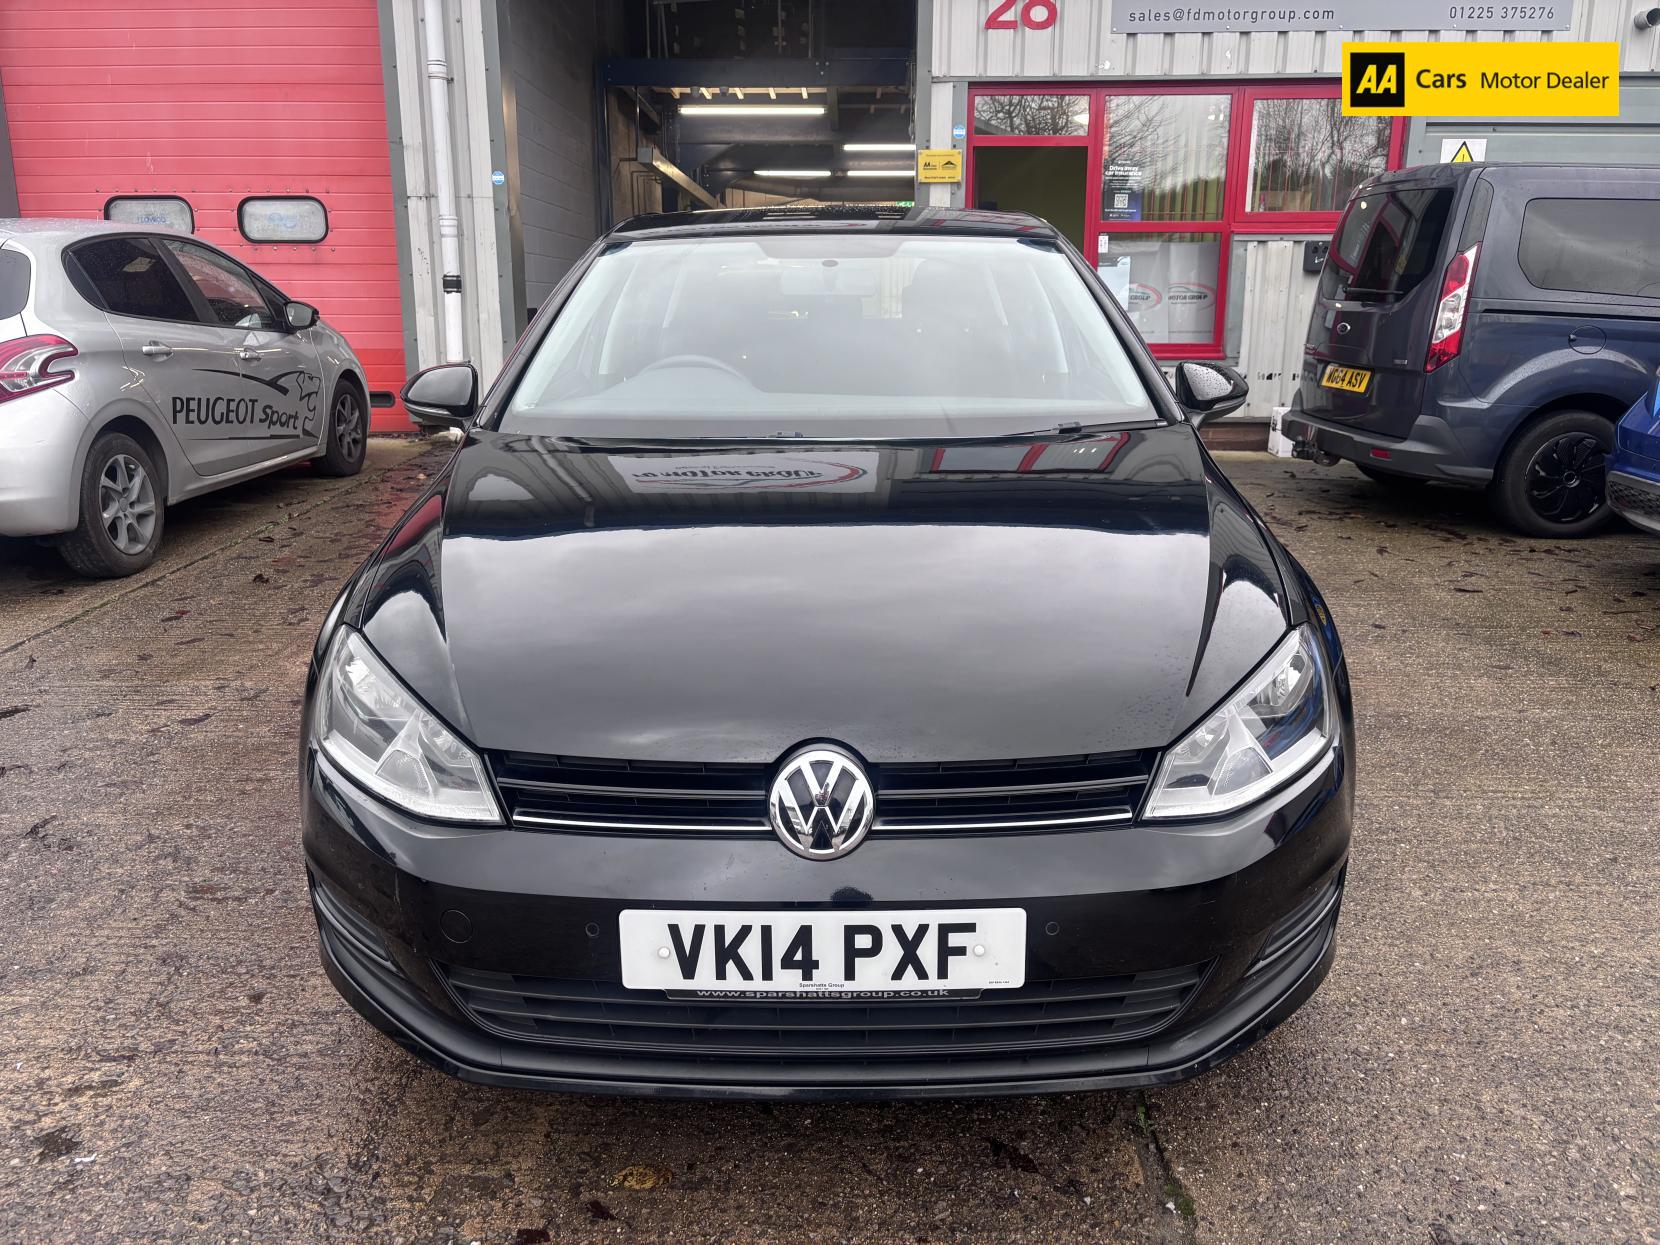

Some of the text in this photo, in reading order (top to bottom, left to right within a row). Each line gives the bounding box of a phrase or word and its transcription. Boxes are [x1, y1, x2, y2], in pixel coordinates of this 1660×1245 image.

[1128, 8, 1335, 23] sales@fdmotorgroup.com
[1449, 6, 1554, 19] 01225 375276
[171, 396, 300, 430] PEUGEOT Sport
[667, 922, 977, 981] VK14 PXF
[696, 989, 950, 999] www.sparshattsgroup.co.uk
